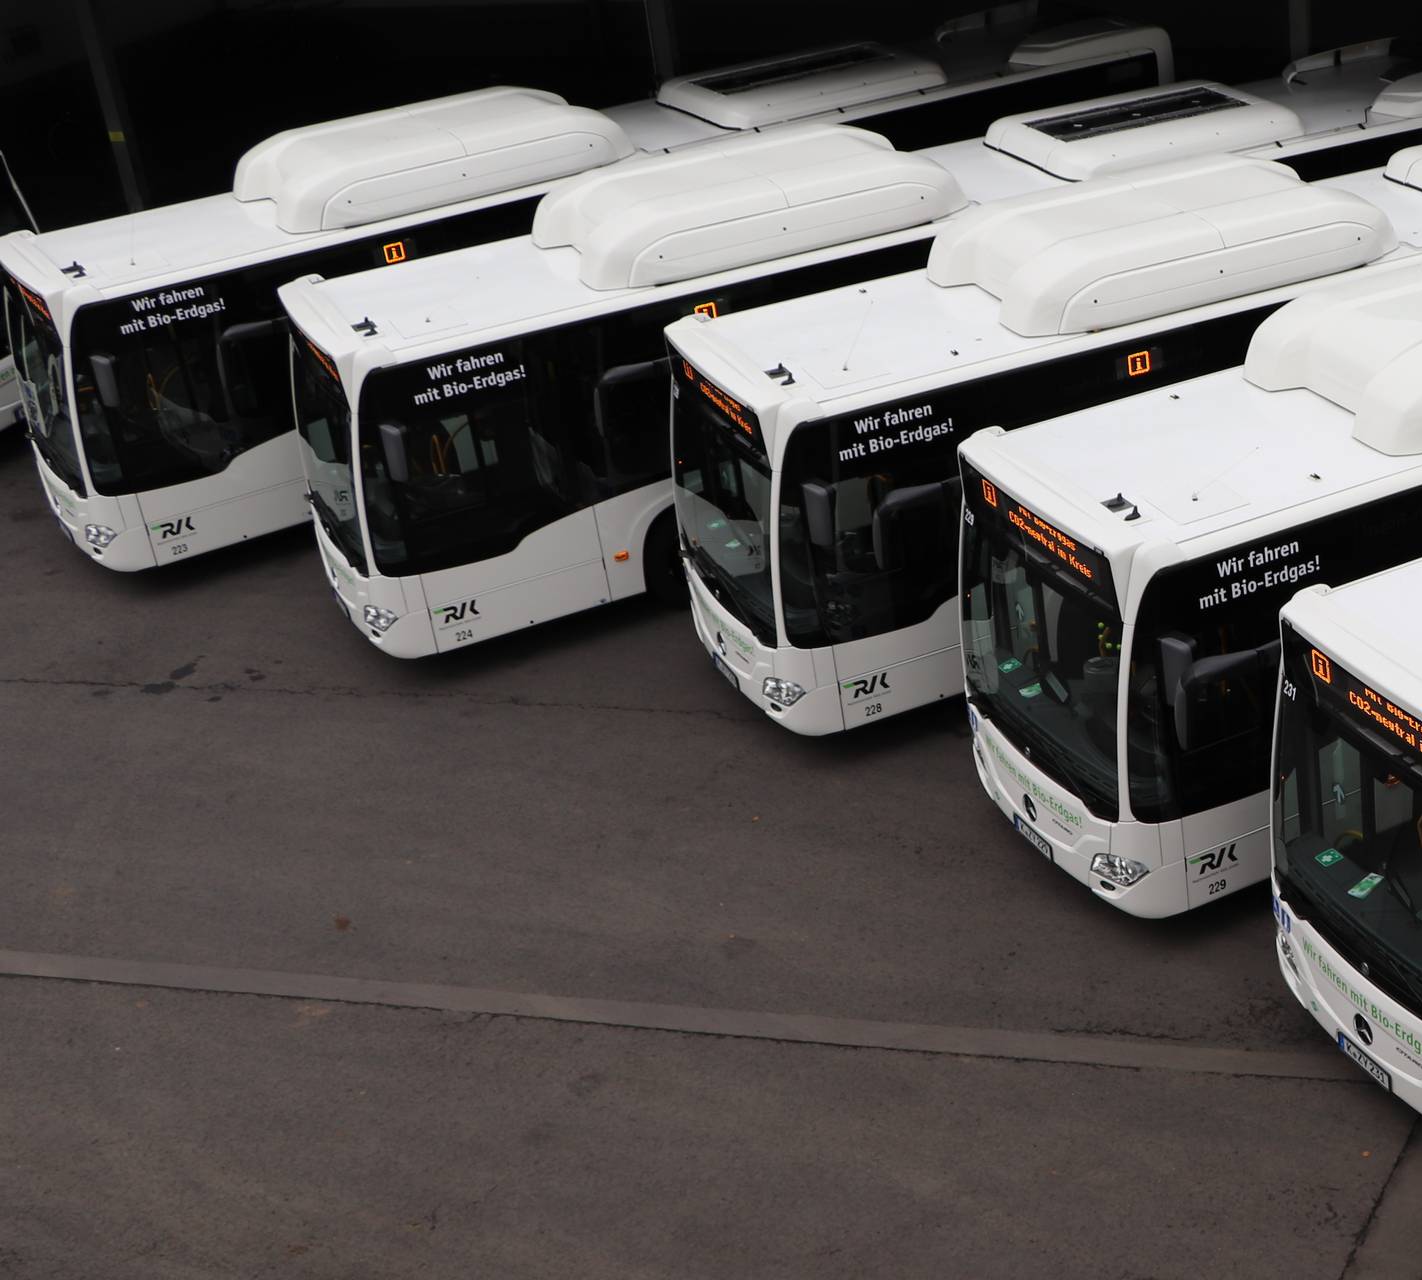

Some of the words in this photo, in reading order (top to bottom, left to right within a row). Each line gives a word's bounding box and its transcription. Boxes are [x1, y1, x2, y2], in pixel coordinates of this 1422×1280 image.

[131, 297, 156, 312] Wir
[158, 286, 205, 306] fahren
[120, 319, 146, 335] mit
[147, 298, 226, 328] Bio-Erdgas!
[427, 363, 453, 380] Wir
[456, 352, 504, 373] fahren
[414, 388, 441, 405] mit
[442, 364, 526, 398] Bio-Erdgas!
[854, 416, 880, 434] Wir
[883, 404, 933, 427] fahren
[839, 443, 866, 461] mit
[869, 417, 954, 454] Bio-Erdgas!
[1217, 557, 1245, 578] Wir
[1248, 541, 1299, 568] fahren
[1199, 587, 1228, 610] mit
[1231, 555, 1320, 599] Bio-Erdgas!
[455, 629, 473, 642] 224
[1283, 680, 1297, 701] 231
[865, 703, 882, 717] 228
[1349, 691, 1416, 746] CO2-neutral
[1208, 879, 1227, 895] 229
[1318, 955, 1348, 993] fahren
[1350, 988, 1368, 1012] mit
